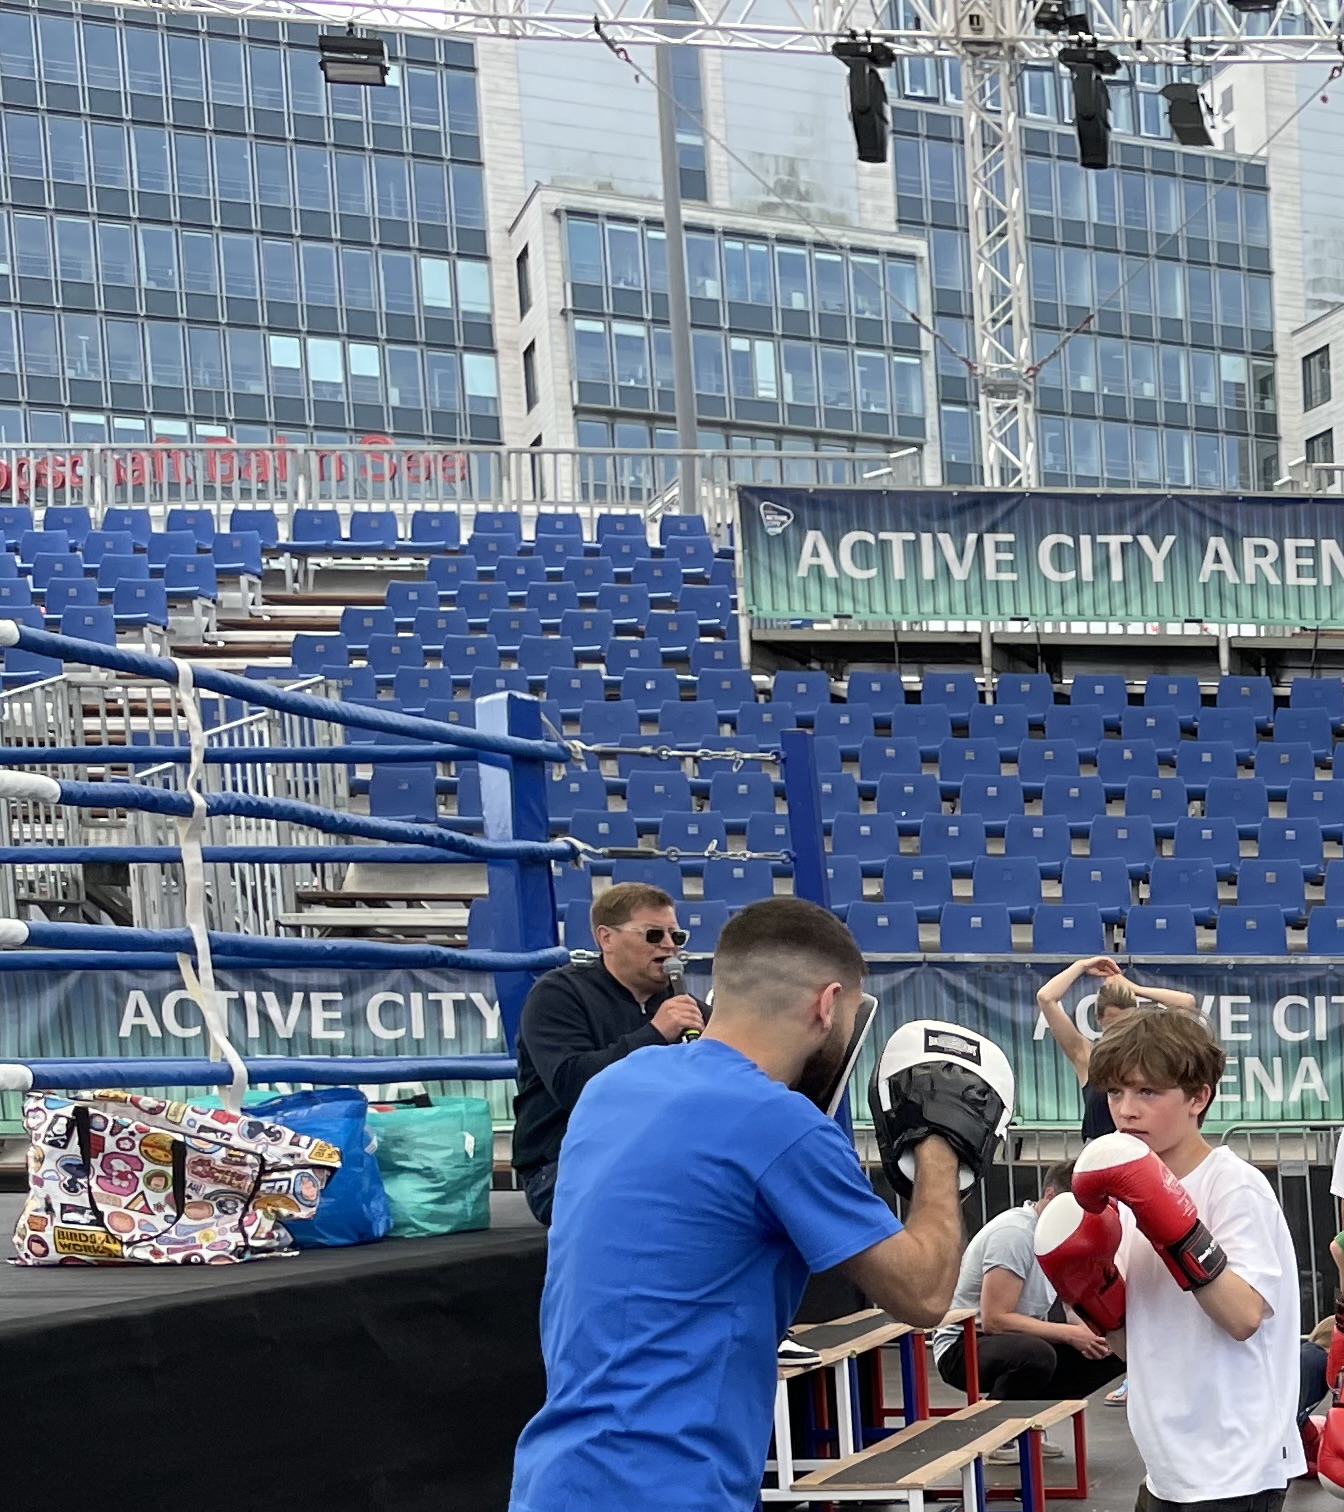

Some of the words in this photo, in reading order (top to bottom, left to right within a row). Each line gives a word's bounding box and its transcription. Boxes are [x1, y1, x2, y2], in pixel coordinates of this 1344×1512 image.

[359, 434, 467, 484] See
[797, 529, 1018, 581] ACTIVE
[1037, 533, 1177, 583] CITY
[366, 991, 502, 1039] CITY
[1213, 1056, 1329, 1102] ENA
[57, 1229, 97, 1244] BIRDS
